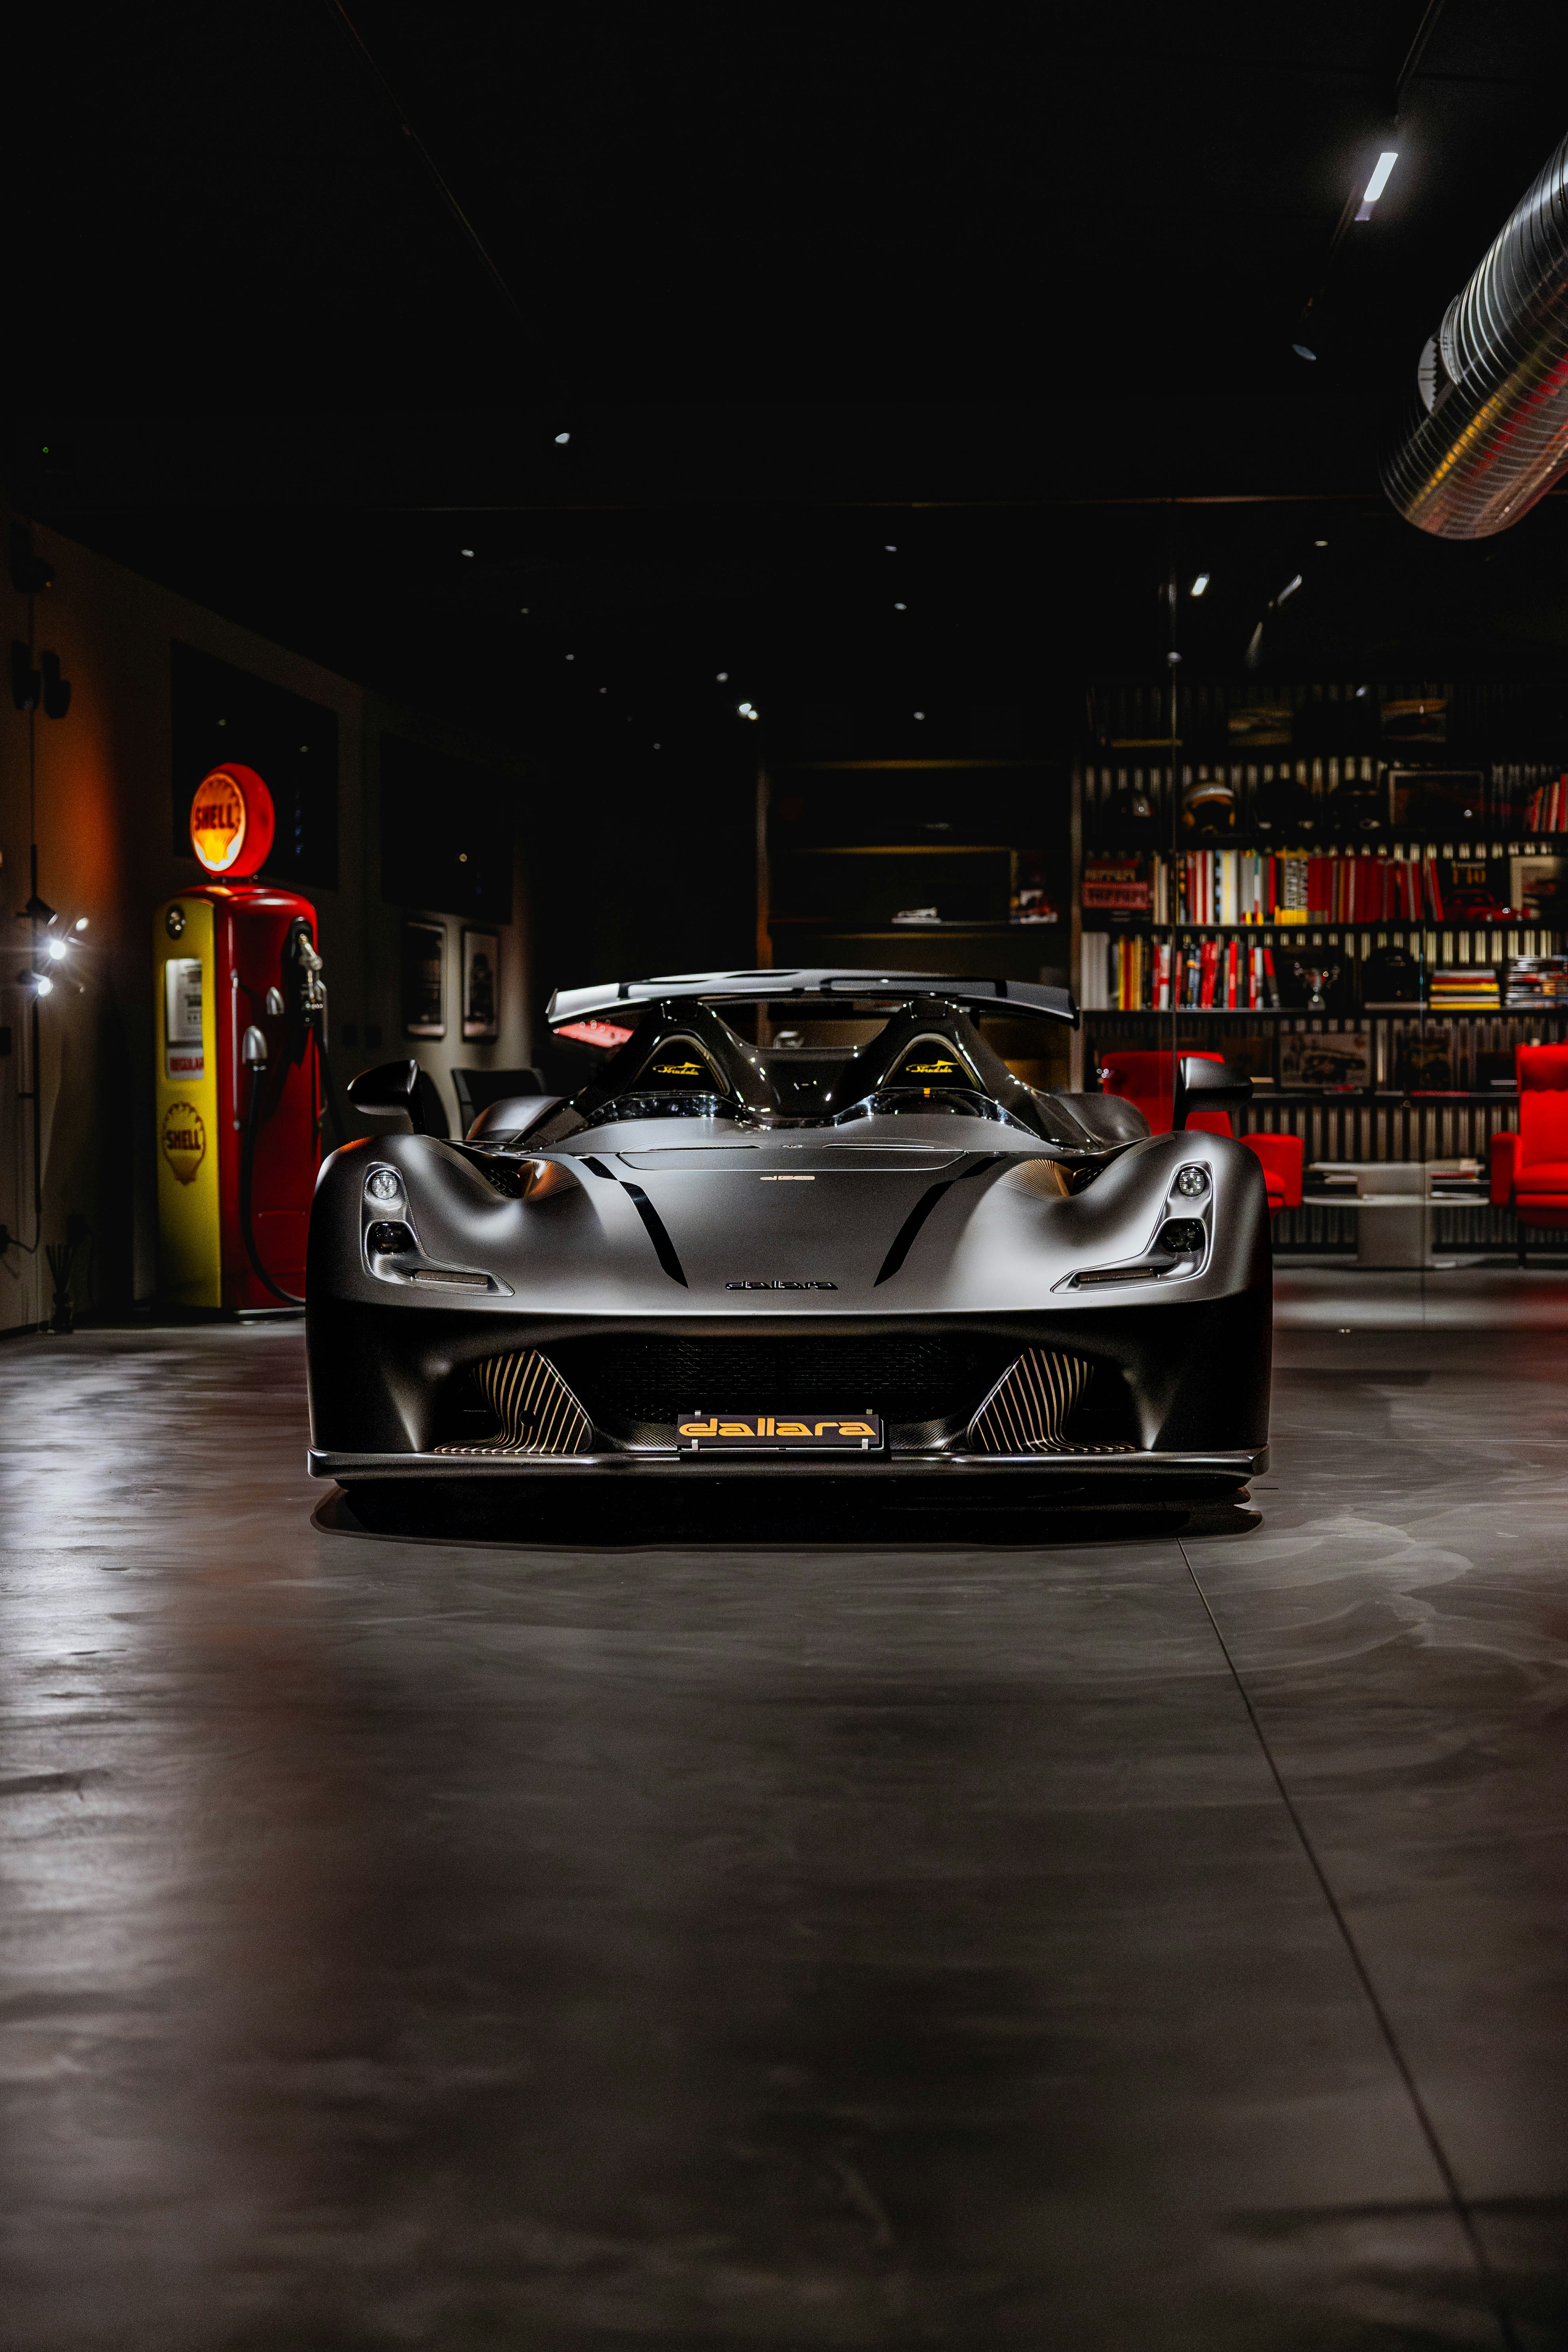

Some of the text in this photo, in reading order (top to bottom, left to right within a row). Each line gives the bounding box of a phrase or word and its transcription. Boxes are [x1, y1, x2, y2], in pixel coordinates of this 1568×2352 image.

[195, 804, 235, 829] SHELL
[167, 1130, 200, 1150] SHELL
[726, 1281, 838, 1290] dallara
[679, 1418, 876, 1436] dallara
